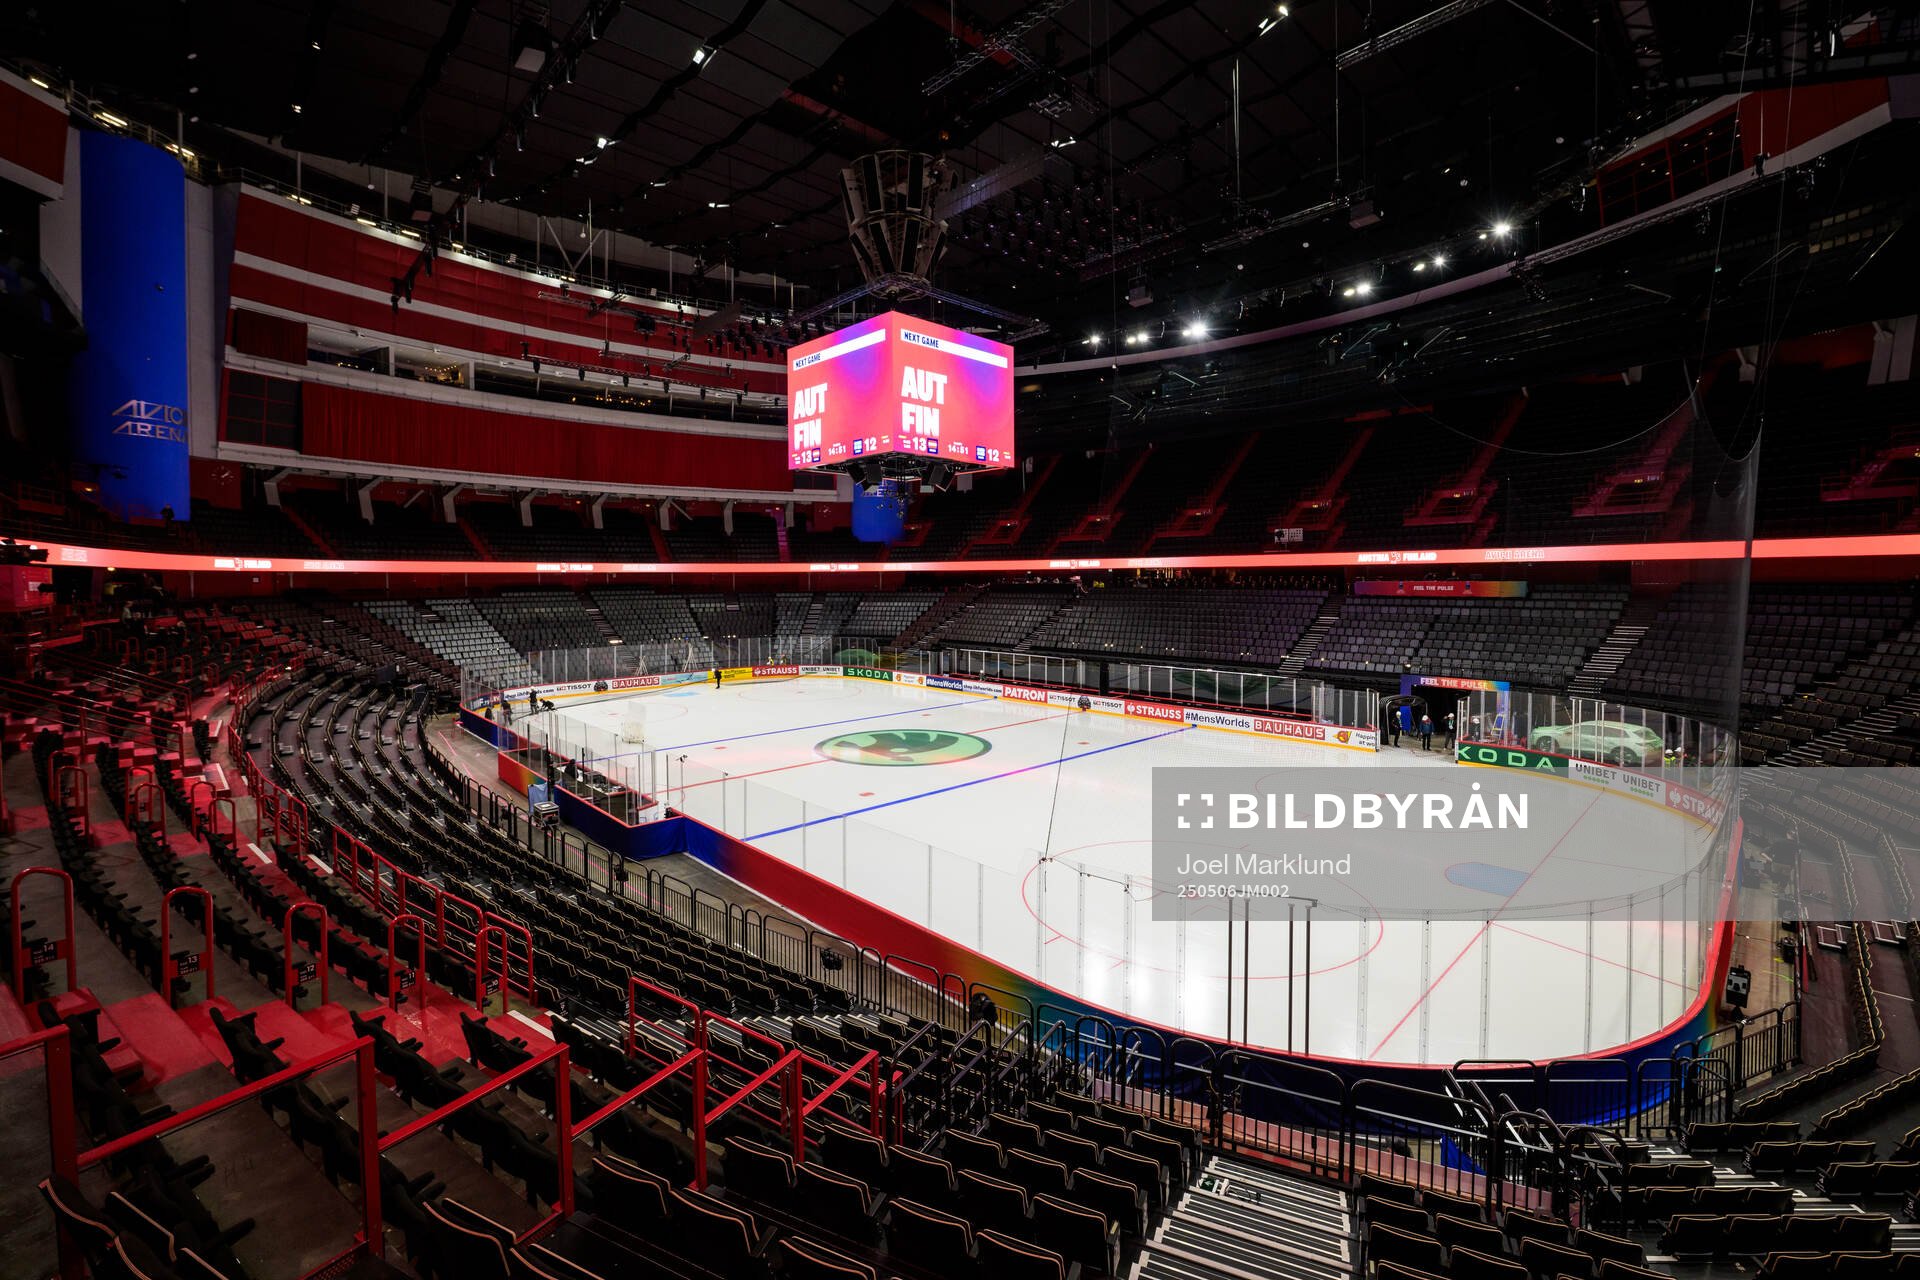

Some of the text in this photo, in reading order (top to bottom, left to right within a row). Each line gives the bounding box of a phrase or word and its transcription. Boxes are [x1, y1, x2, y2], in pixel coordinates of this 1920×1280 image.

[904, 332, 939, 348] NEXT GAME
[795, 353, 821, 368] NEXT GAME
[901, 365, 948, 405] AUT
[793, 382, 828, 420] AUT
[901, 402, 940, 437] FIN
[793, 418, 822, 450] FIN
[864, 437, 877, 451] 12
[912, 436, 927, 452] 13
[801, 451, 812, 464] 13
[987, 448, 1000, 462] 12
[761, 666, 797, 676] STRAUSS
[613, 677, 660, 689] BAUHAUS
[926, 678, 963, 690] #MensWorlds
[1420, 677, 1489, 690] FEEL THE PULSE
[1005, 687, 1045, 701] PATRON
[1101, 701, 1123, 709] TISSOT
[1136, 705, 1182, 719] STRAUSS
[1185, 712, 1250, 729] #MensWorlds
[1255, 721, 1324, 738] BAUHAUS
[1575, 763, 1661, 793] UNIBET UNIBET
[43, 943, 54, 952] 14
[188, 955, 198, 964] 13
